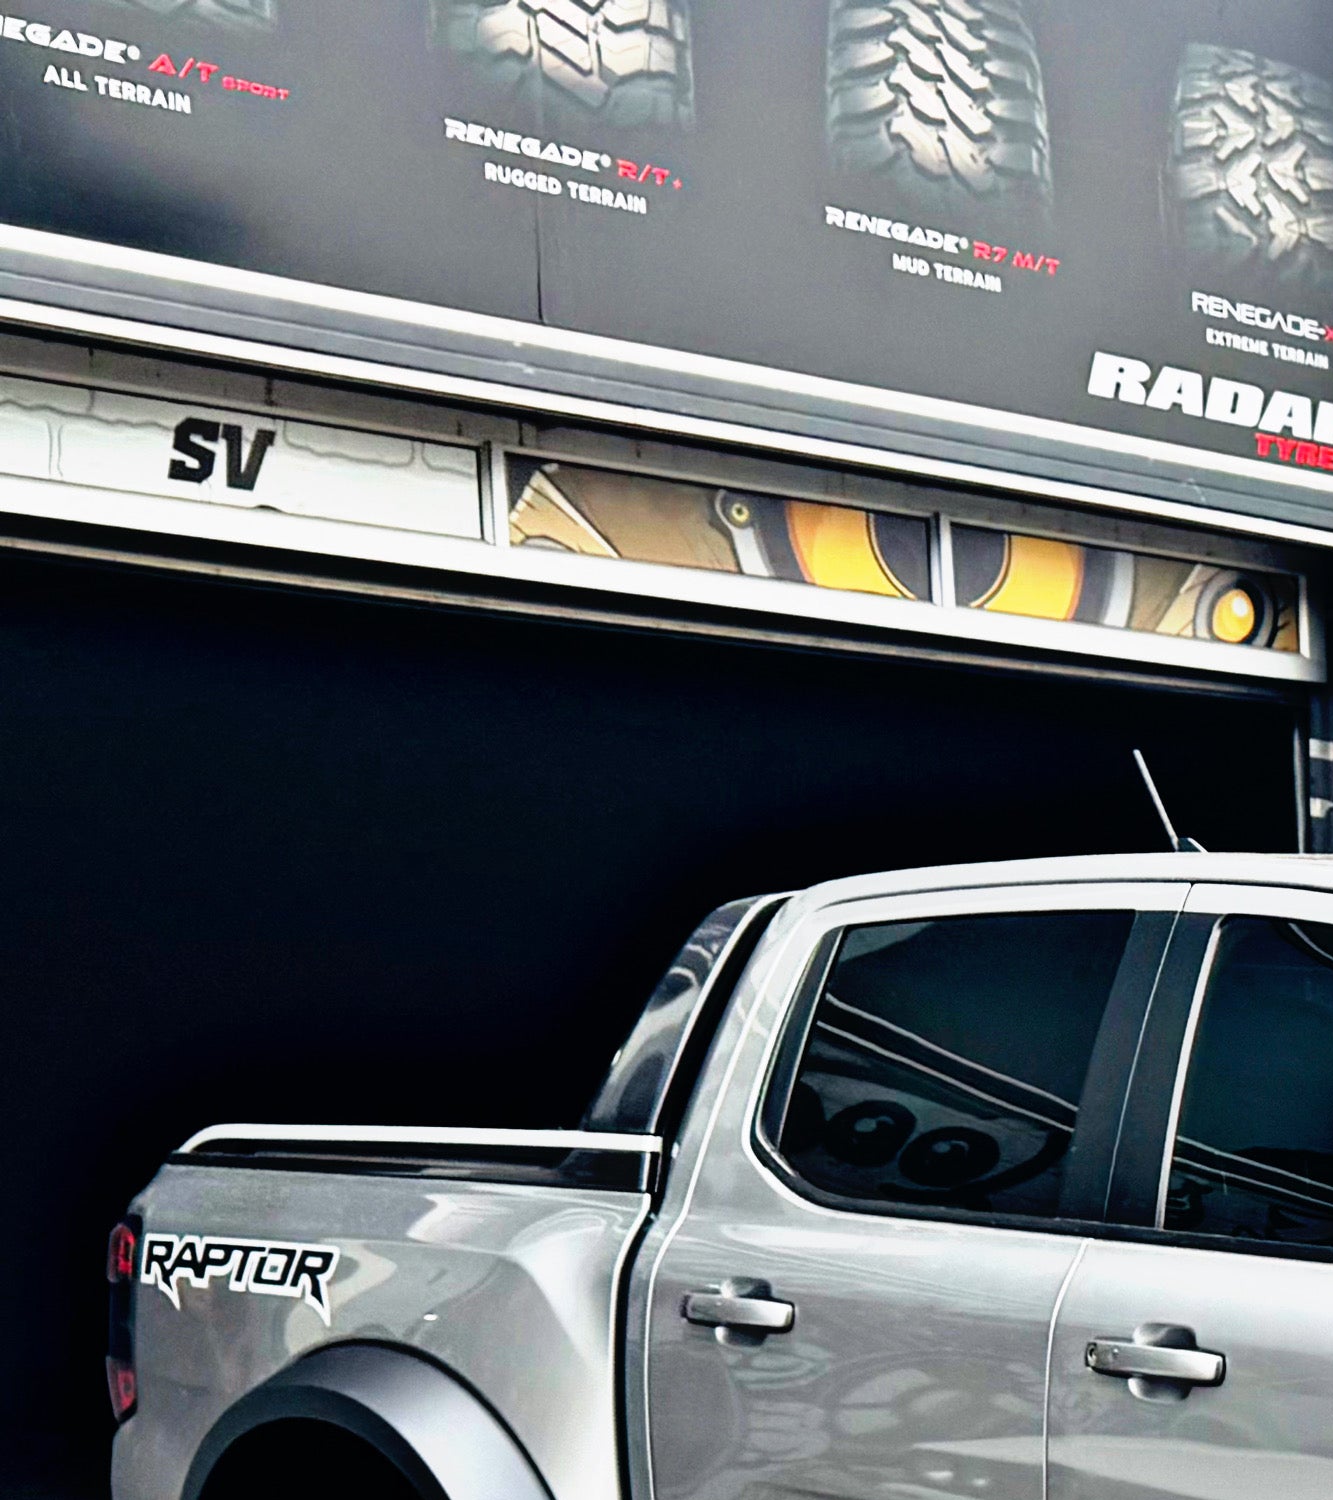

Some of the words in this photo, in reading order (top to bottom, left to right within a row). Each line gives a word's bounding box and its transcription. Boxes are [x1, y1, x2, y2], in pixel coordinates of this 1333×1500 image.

[0, 15, 133, 64] EGADE
[148, 53, 220, 82] A/T
[222, 76, 290, 101] SPORT
[44, 64, 88, 92] ALL
[94, 75, 192, 114] TERRAIN
[484, 162, 562, 195] RUGGED
[567, 180, 647, 214] TERRAIN
[892, 253, 930, 276] MUD
[933, 262, 1002, 293] TERRAIN
[1012, 250, 1060, 277] M/T
[1206, 327, 1269, 357] EXTREME
[1272, 342, 1329, 370] TERRAIN
[168, 417, 274, 491] SV
[141, 1233, 340, 1327] RAPTOR
